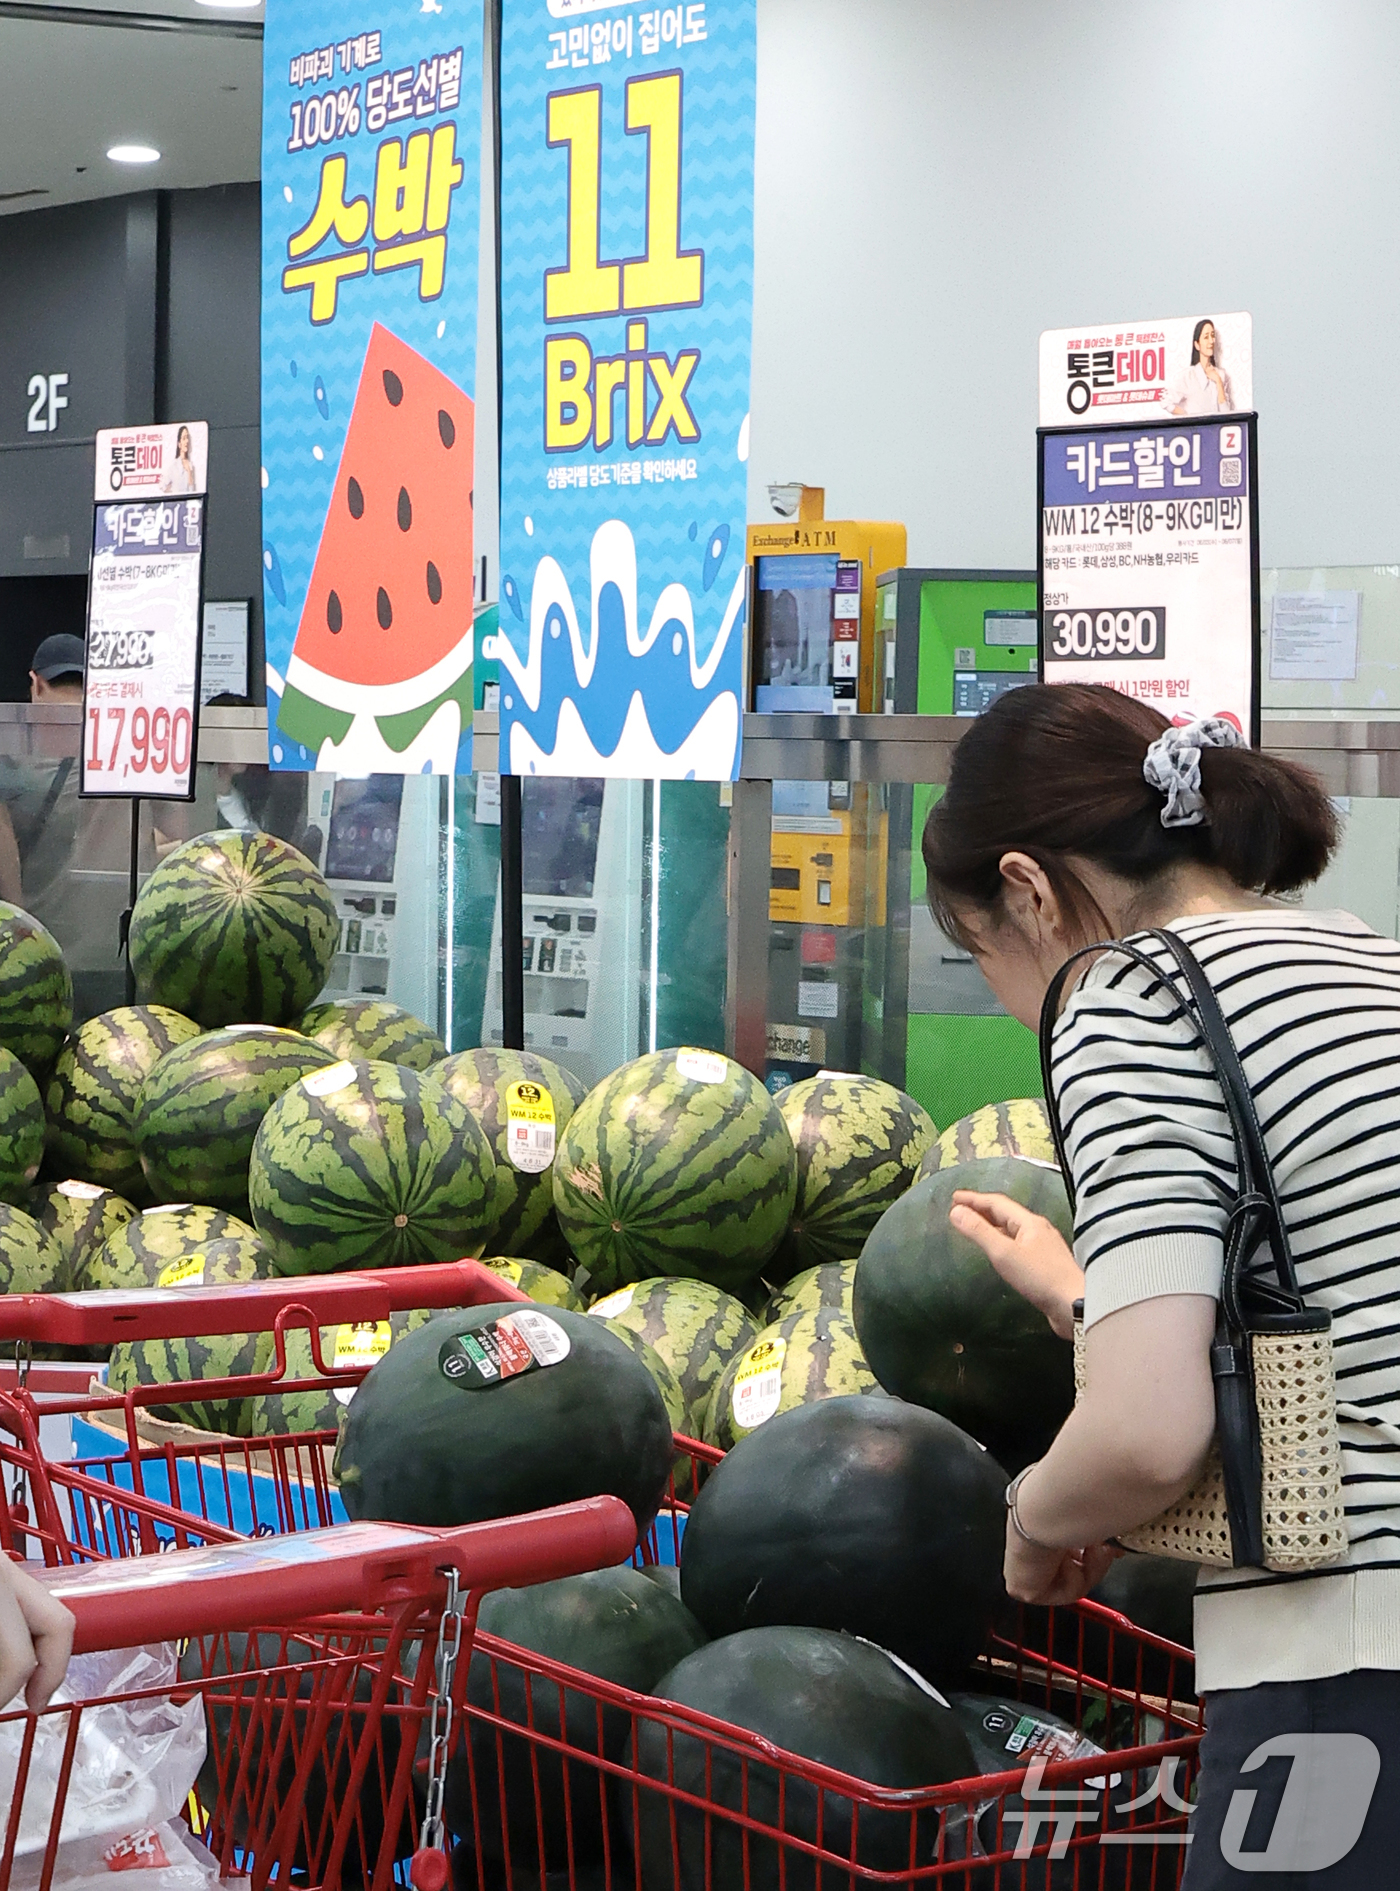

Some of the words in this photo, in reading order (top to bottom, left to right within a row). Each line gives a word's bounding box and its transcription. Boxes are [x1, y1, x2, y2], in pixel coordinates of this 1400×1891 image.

[289, 46, 334, 87] 비파괴
[337, 32, 382, 72] 기계로
[546, 15, 633, 69] 고민없이
[638, 4, 708, 55] 집어도
[288, 87, 360, 149] 100%
[366, 51, 462, 130] 당도선별
[546, 75, 702, 319] 11
[283, 124, 461, 321] 수박
[28, 373, 68, 432] 2F
[546, 323, 699, 448] Brix
[1067, 347, 1165, 415] 통큰데이
[110, 444, 163, 492] 통큰데이
[546, 465, 588, 489] 상품라벨
[643, 458, 698, 483] 확인하세요
[1066, 434, 1201, 493] 카드할인
[753, 535, 795, 548] Exchange
[1044, 508, 1076, 536] WM
[1081, 507, 1100, 534] 12
[1045, 557, 1060, 570] 해당
[1062, 557, 1077, 569] 카드
[1044, 592, 1068, 606] 정상가
[1052, 610, 1157, 657] 30,990
[1119, 680, 1129, 696] 시
[1132, 679, 1162, 697] 1만원
[1166, 679, 1190, 698] 할인
[87, 707, 192, 777] 17,990
[521, 1086, 536, 1096] 12
[511, 1110, 526, 1118] WM
[528, 1112, 537, 1120] 12
[370, 1346, 386, 1354] 수박
[447, 1359, 462, 1373] 11
[988, 1716, 1004, 1728] 11
